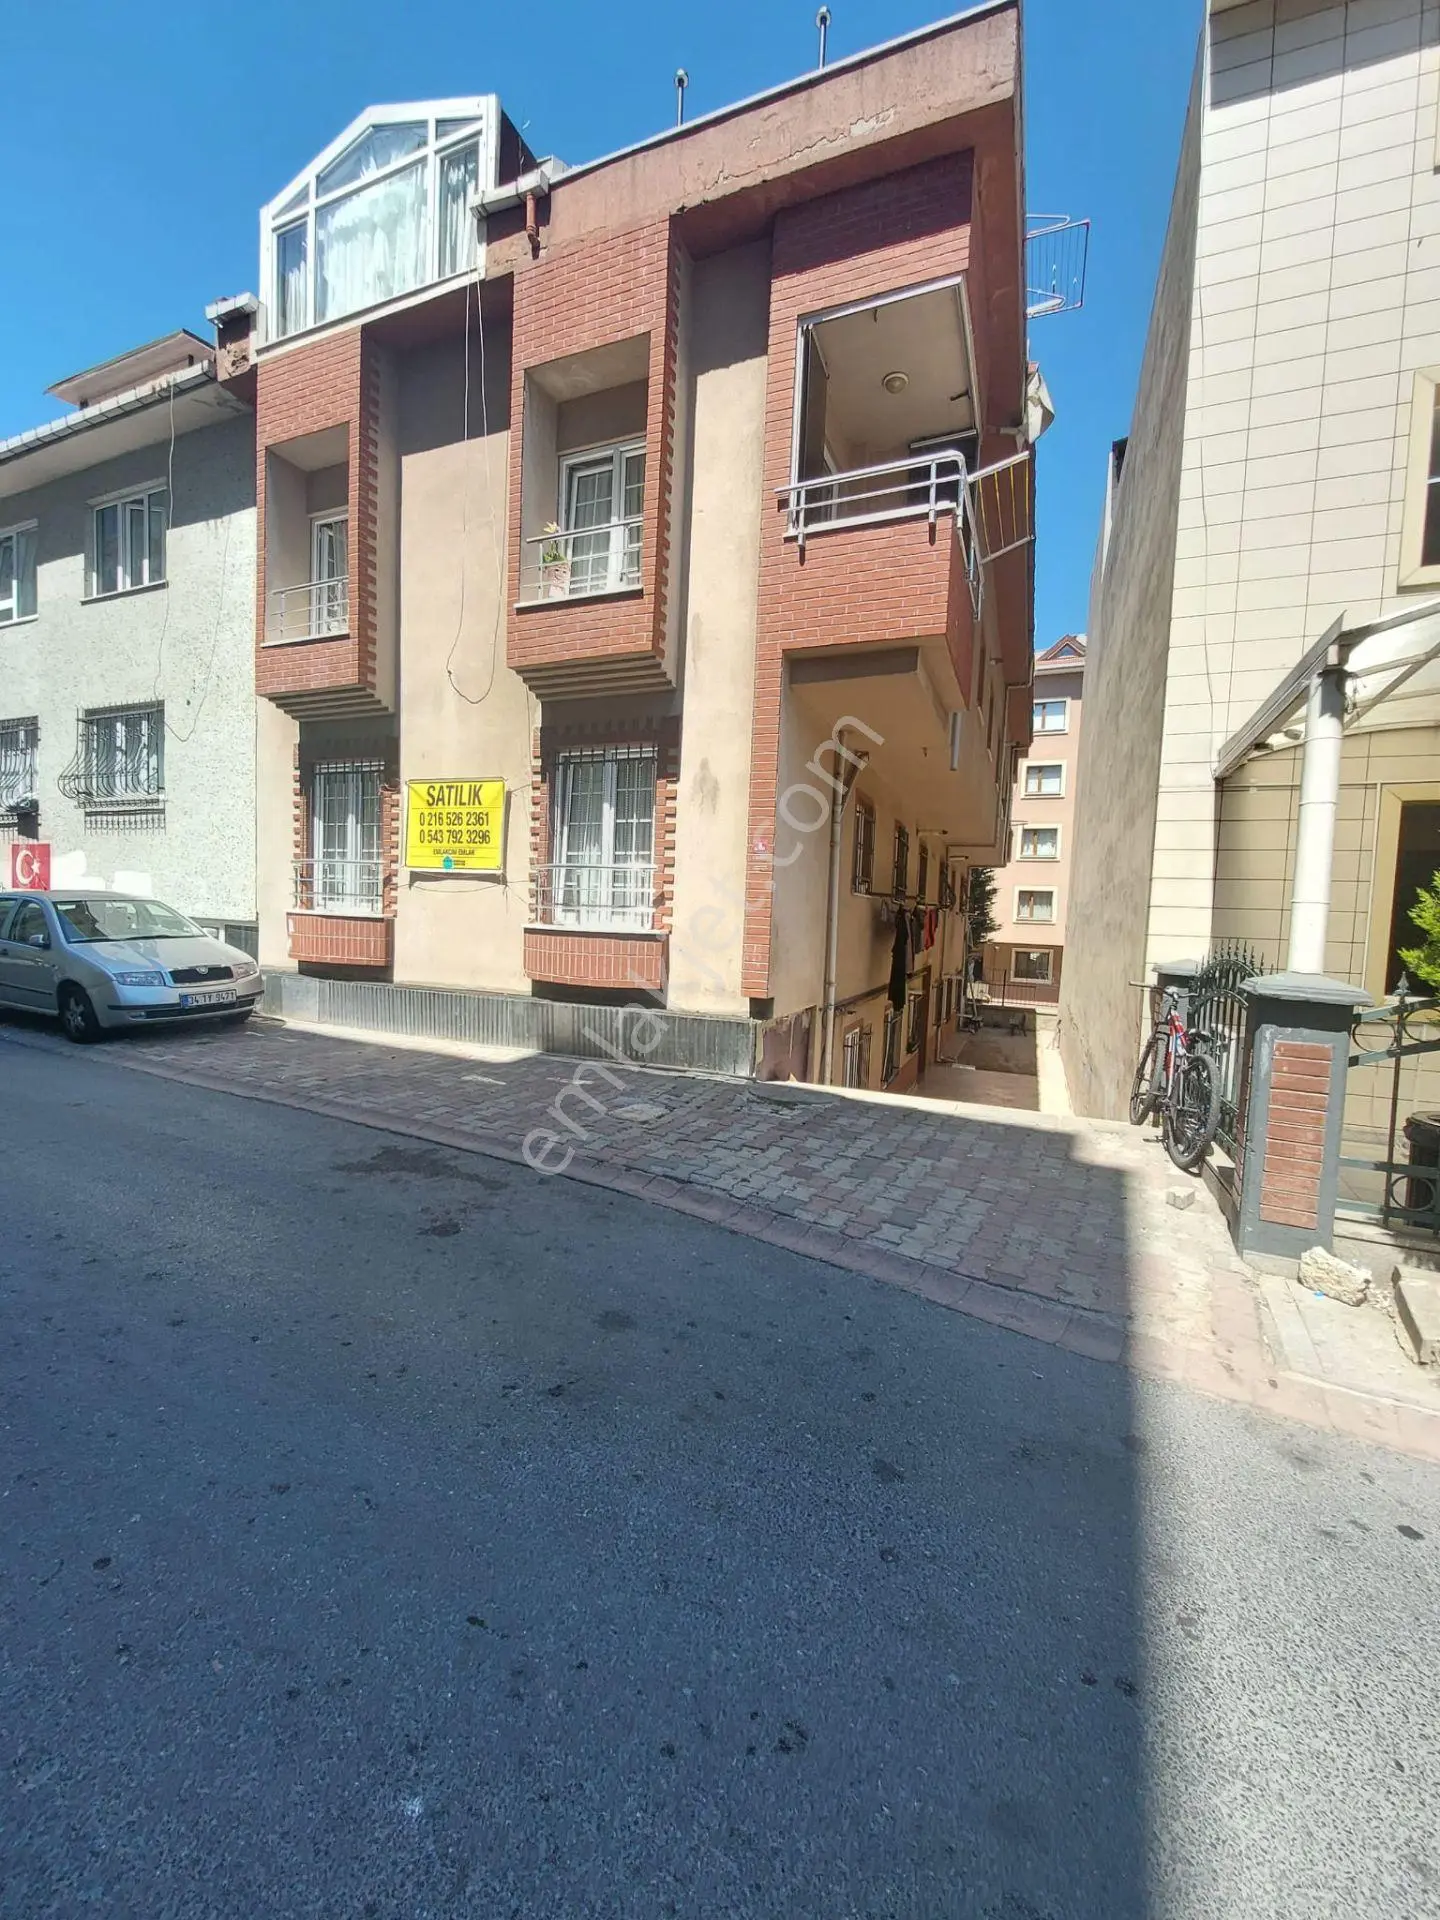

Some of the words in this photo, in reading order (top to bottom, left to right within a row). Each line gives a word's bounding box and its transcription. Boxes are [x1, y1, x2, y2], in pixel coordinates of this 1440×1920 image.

[426, 784, 483, 807] SATILIK
[419, 812, 425, 826] 0
[427, 812, 443, 826] 216
[446, 812, 463, 826] 526
[466, 811, 489, 826] 2361
[419, 829, 425, 844] 0
[427, 829, 443, 844] 543
[447, 829, 463, 844] 792
[466, 830, 491, 844] 3296
